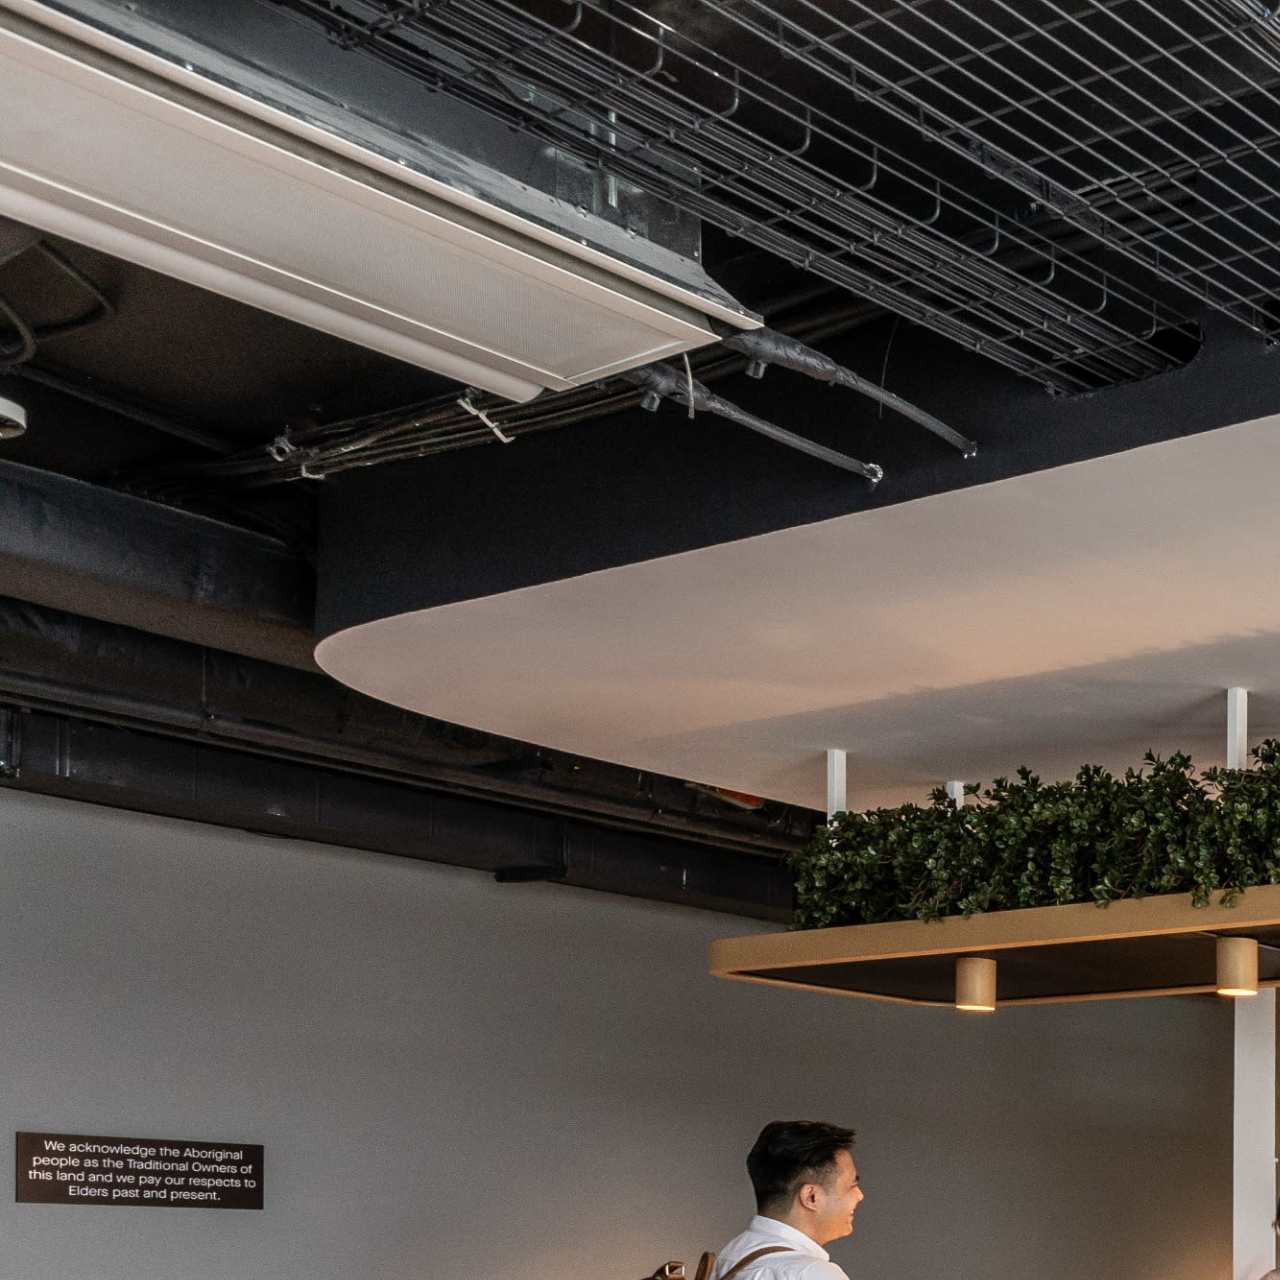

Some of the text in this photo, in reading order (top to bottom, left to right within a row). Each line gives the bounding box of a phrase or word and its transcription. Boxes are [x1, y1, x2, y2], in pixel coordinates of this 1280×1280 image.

[44, 1140, 243, 1162] We acknowledge the Aboriginal
[32, 1156, 253, 1174] people as the Traditional Owners of
[28, 1169, 257, 1189] this land and we pay our respects to
[68, 1185, 221, 1202] Elders past and present.
